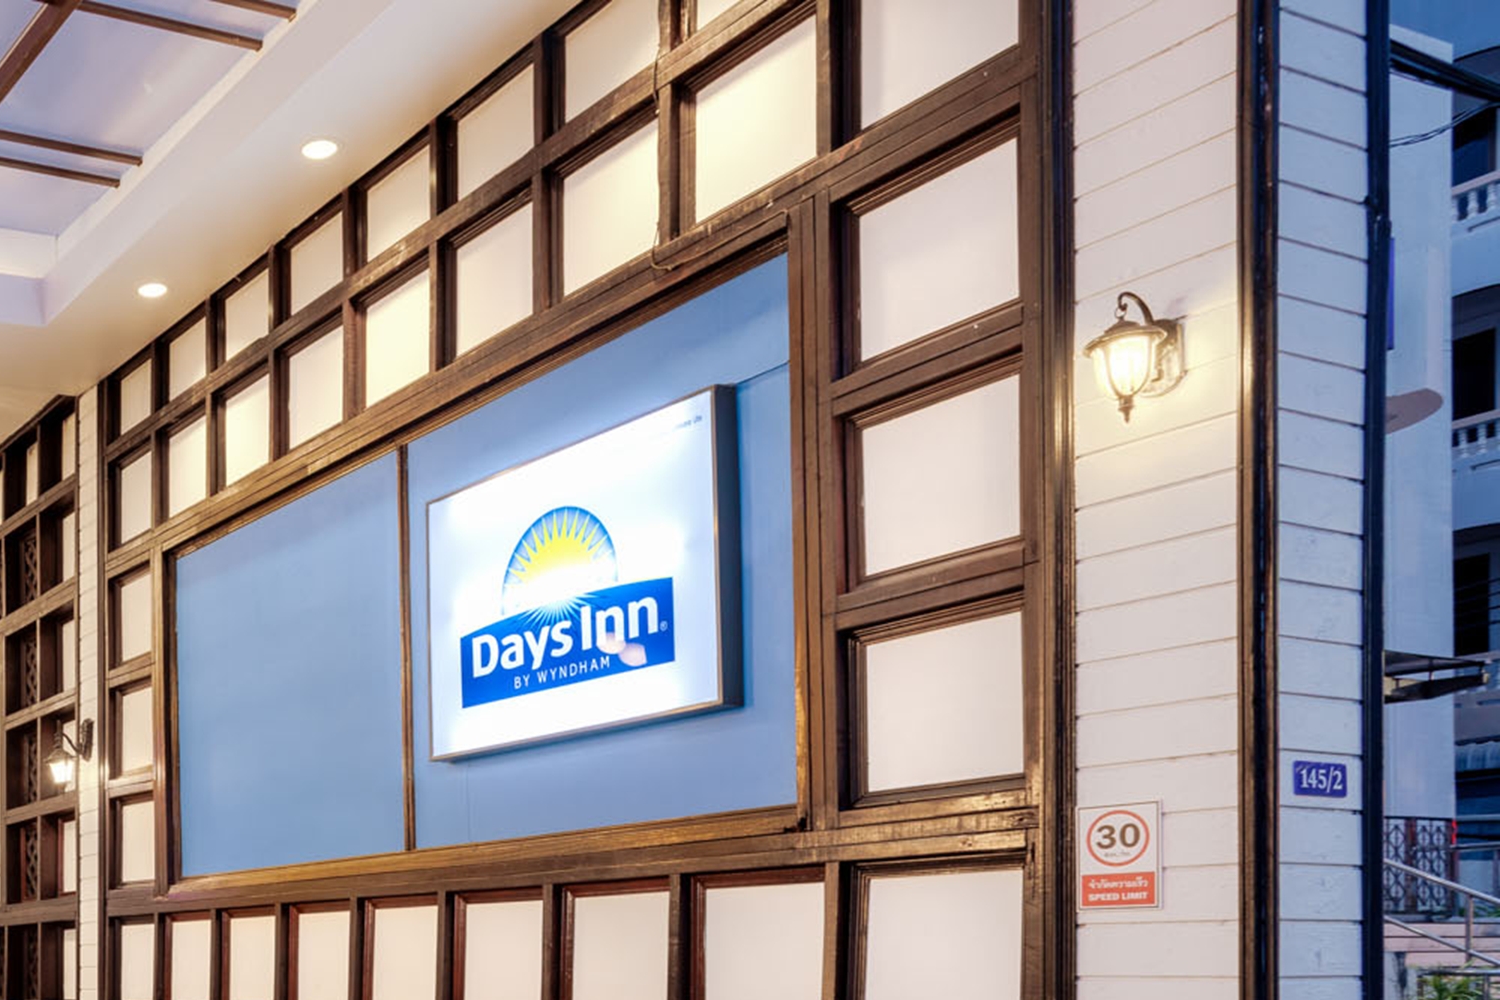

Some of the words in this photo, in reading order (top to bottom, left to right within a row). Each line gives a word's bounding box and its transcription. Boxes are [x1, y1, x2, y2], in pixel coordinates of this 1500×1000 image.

[472, 620, 573, 679] Days
[580, 597, 658, 652] Inn
[513, 674, 531, 689] BY
[536, 655, 611, 684] WYNDHAM
[1300, 766, 1343, 793] 145/2
[1096, 823, 1140, 849] 30
[1088, 892, 1120, 902] SPEED
[1121, 891, 1149, 901] LIMIT
